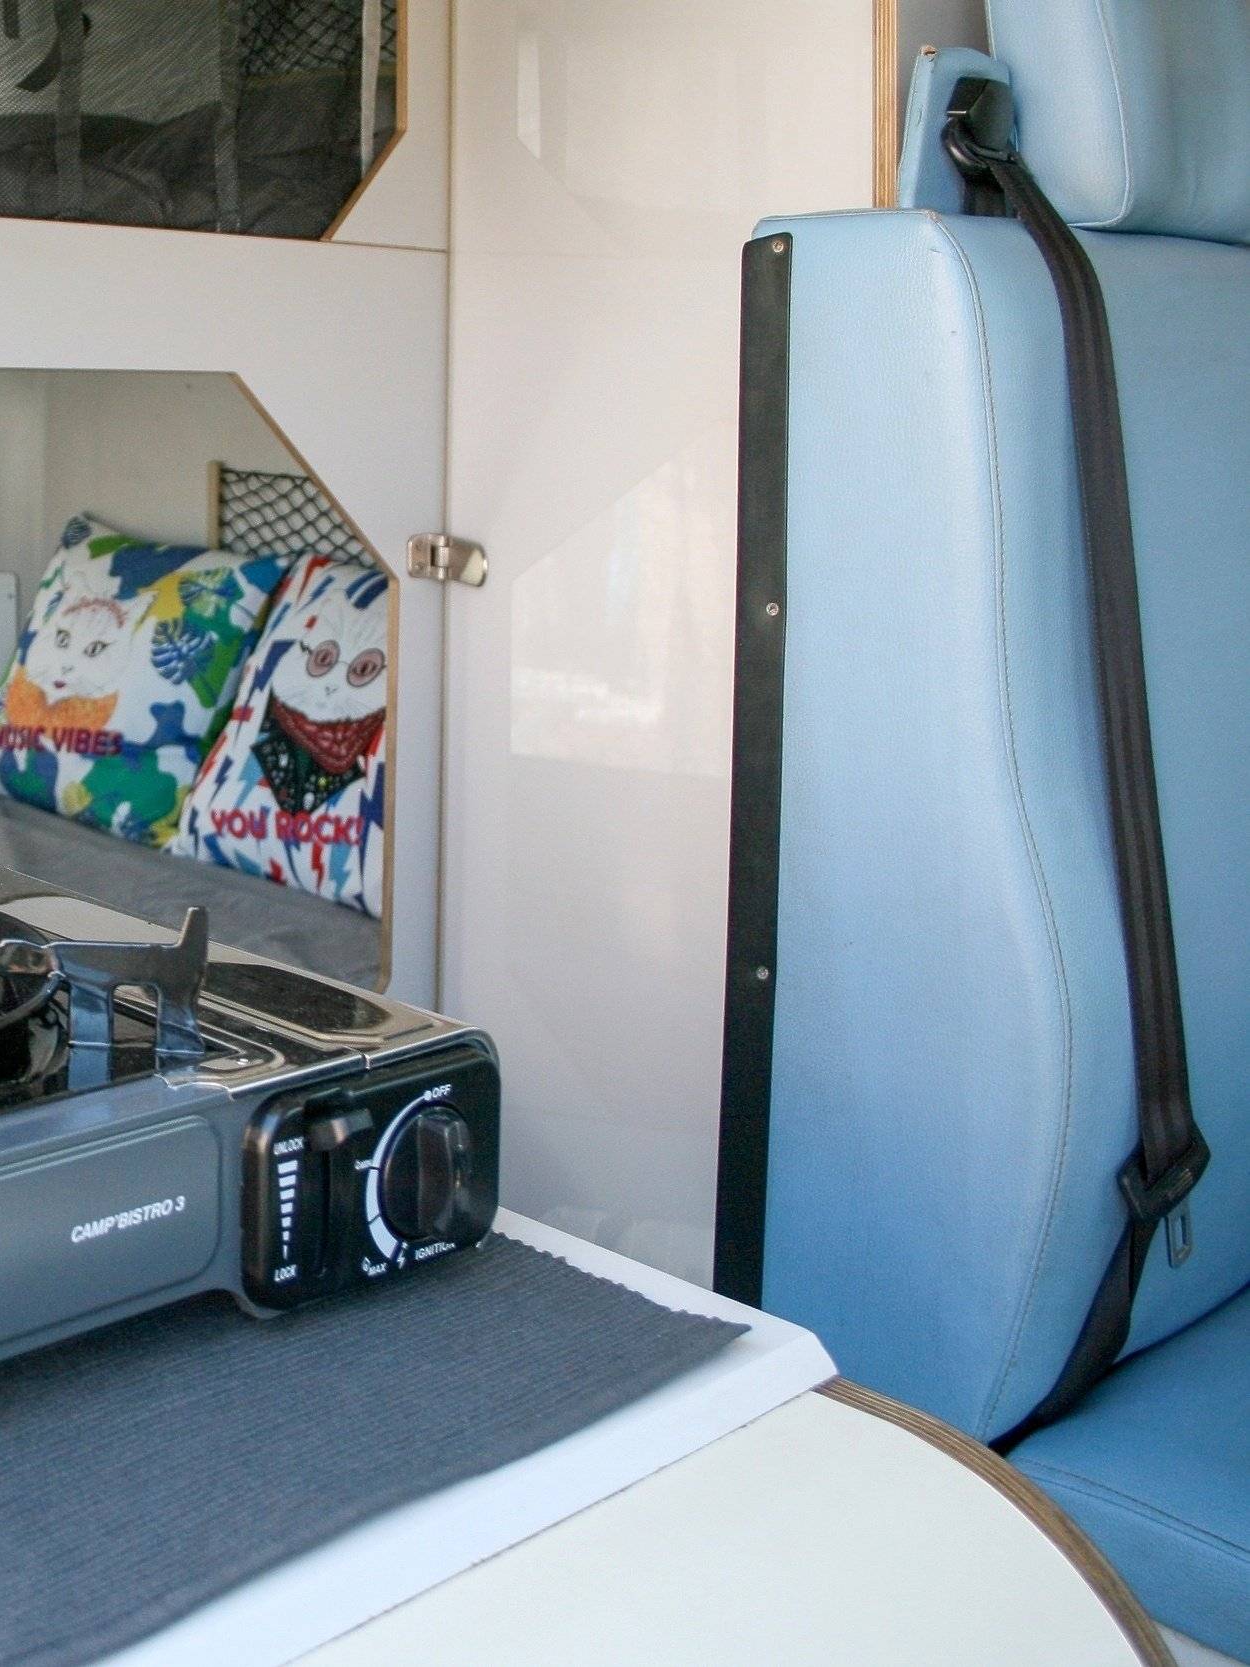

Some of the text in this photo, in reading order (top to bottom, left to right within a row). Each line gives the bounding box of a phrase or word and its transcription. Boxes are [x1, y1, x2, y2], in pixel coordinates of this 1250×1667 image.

[53, 726, 124, 755] VIBES
[210, 808, 364, 845] YOU ROCK!
[432, 1084, 452, 1098] OFF
[273, 1137, 304, 1155] UNLOCK
[71, 1195, 186, 1243] CAMP'BISTRO 3
[274, 1264, 298, 1283] LOCK
[367, 1262, 387, 1277] MAX
